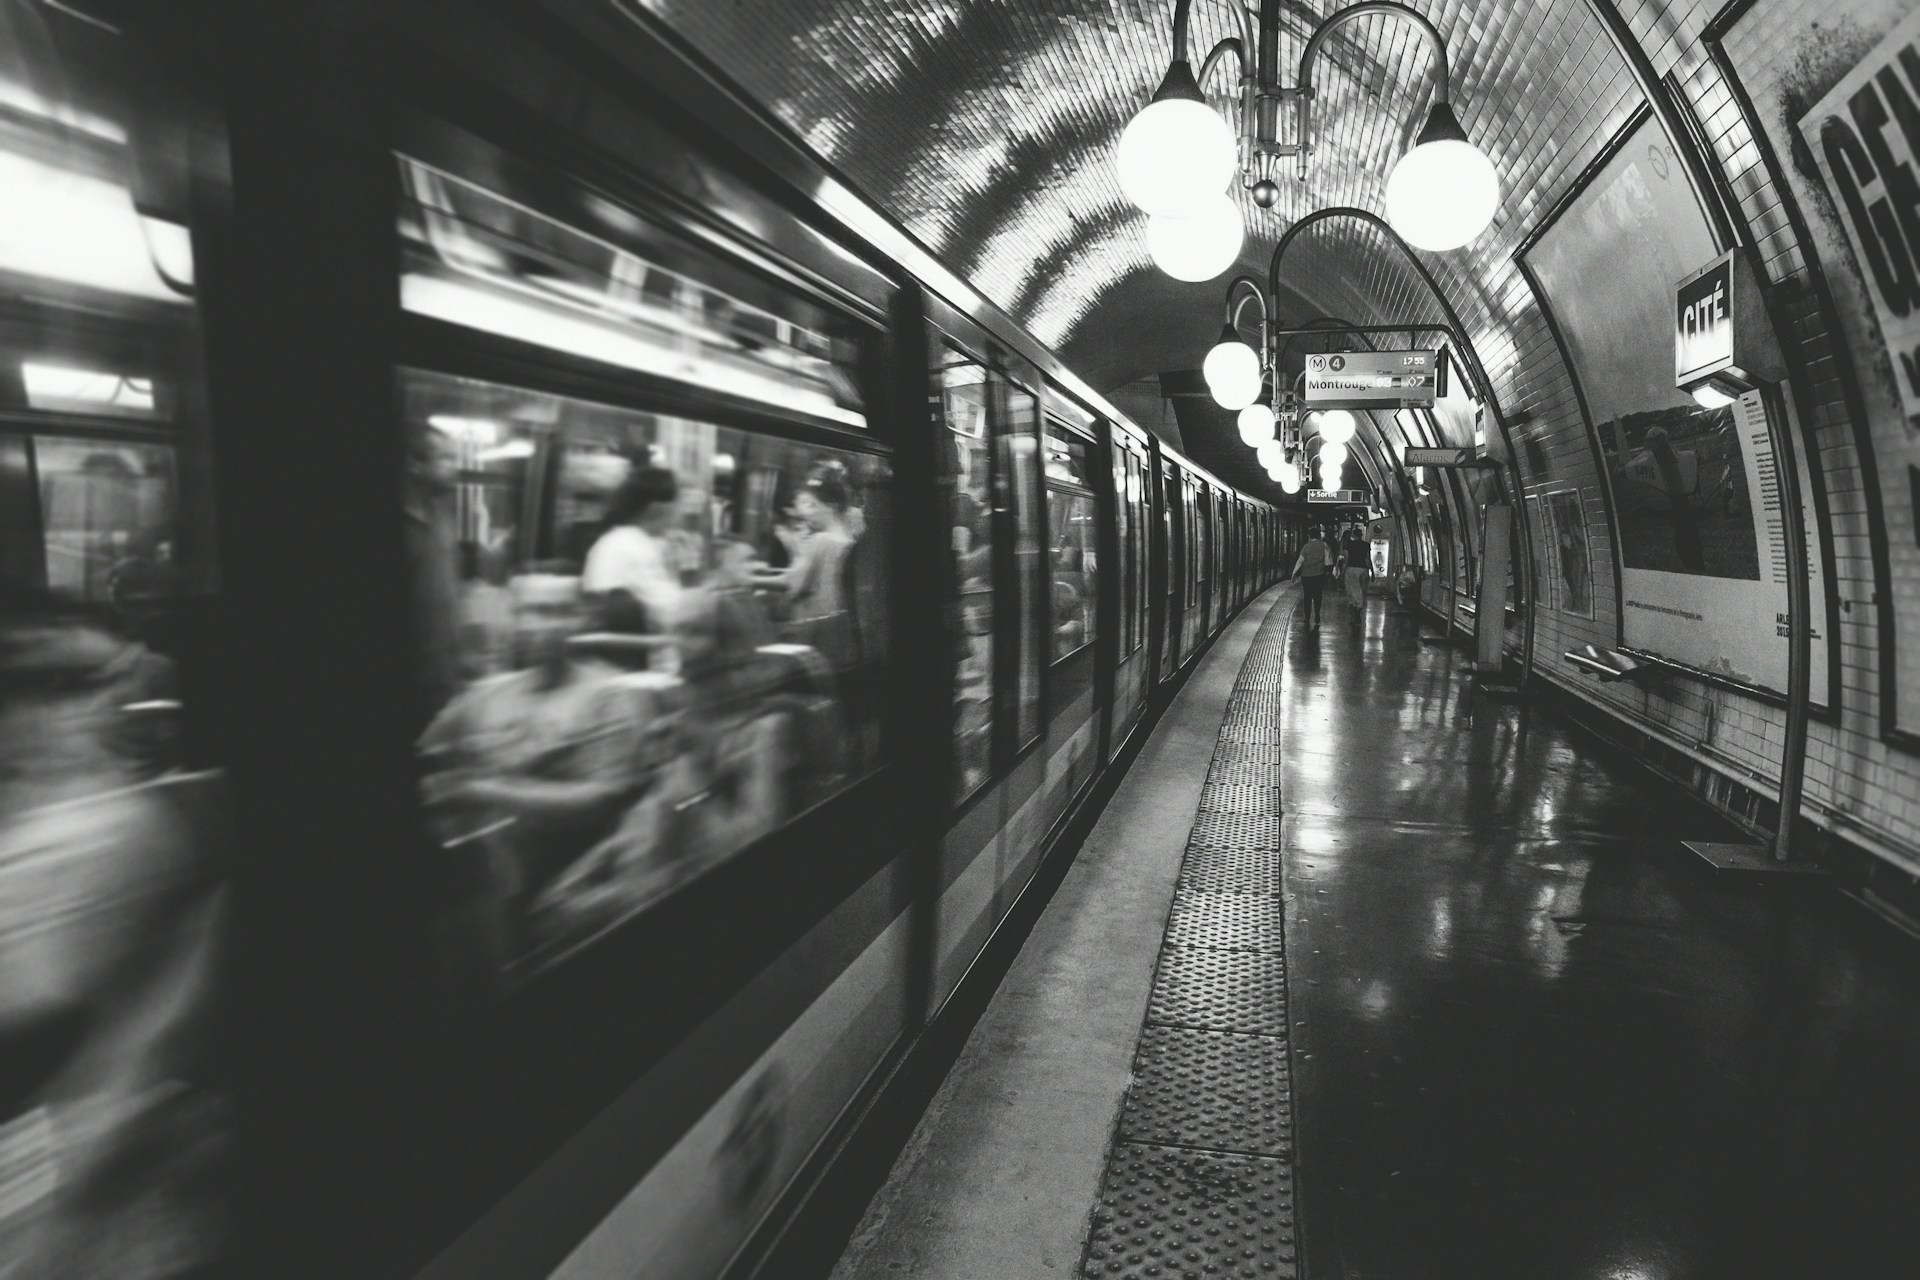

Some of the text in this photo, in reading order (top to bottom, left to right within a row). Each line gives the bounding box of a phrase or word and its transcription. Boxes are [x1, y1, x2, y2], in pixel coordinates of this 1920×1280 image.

[1683, 279, 1724, 347] CITÉ
[1308, 380, 1373, 391] Montrouge
[1408, 376, 1425, 388] 07
[1412, 453, 1449, 464] Alarme
[1316, 491, 1338, 499] Sortie
[1776, 612, 1789, 625] ARLE
[1776, 625, 1789, 638] 2015
